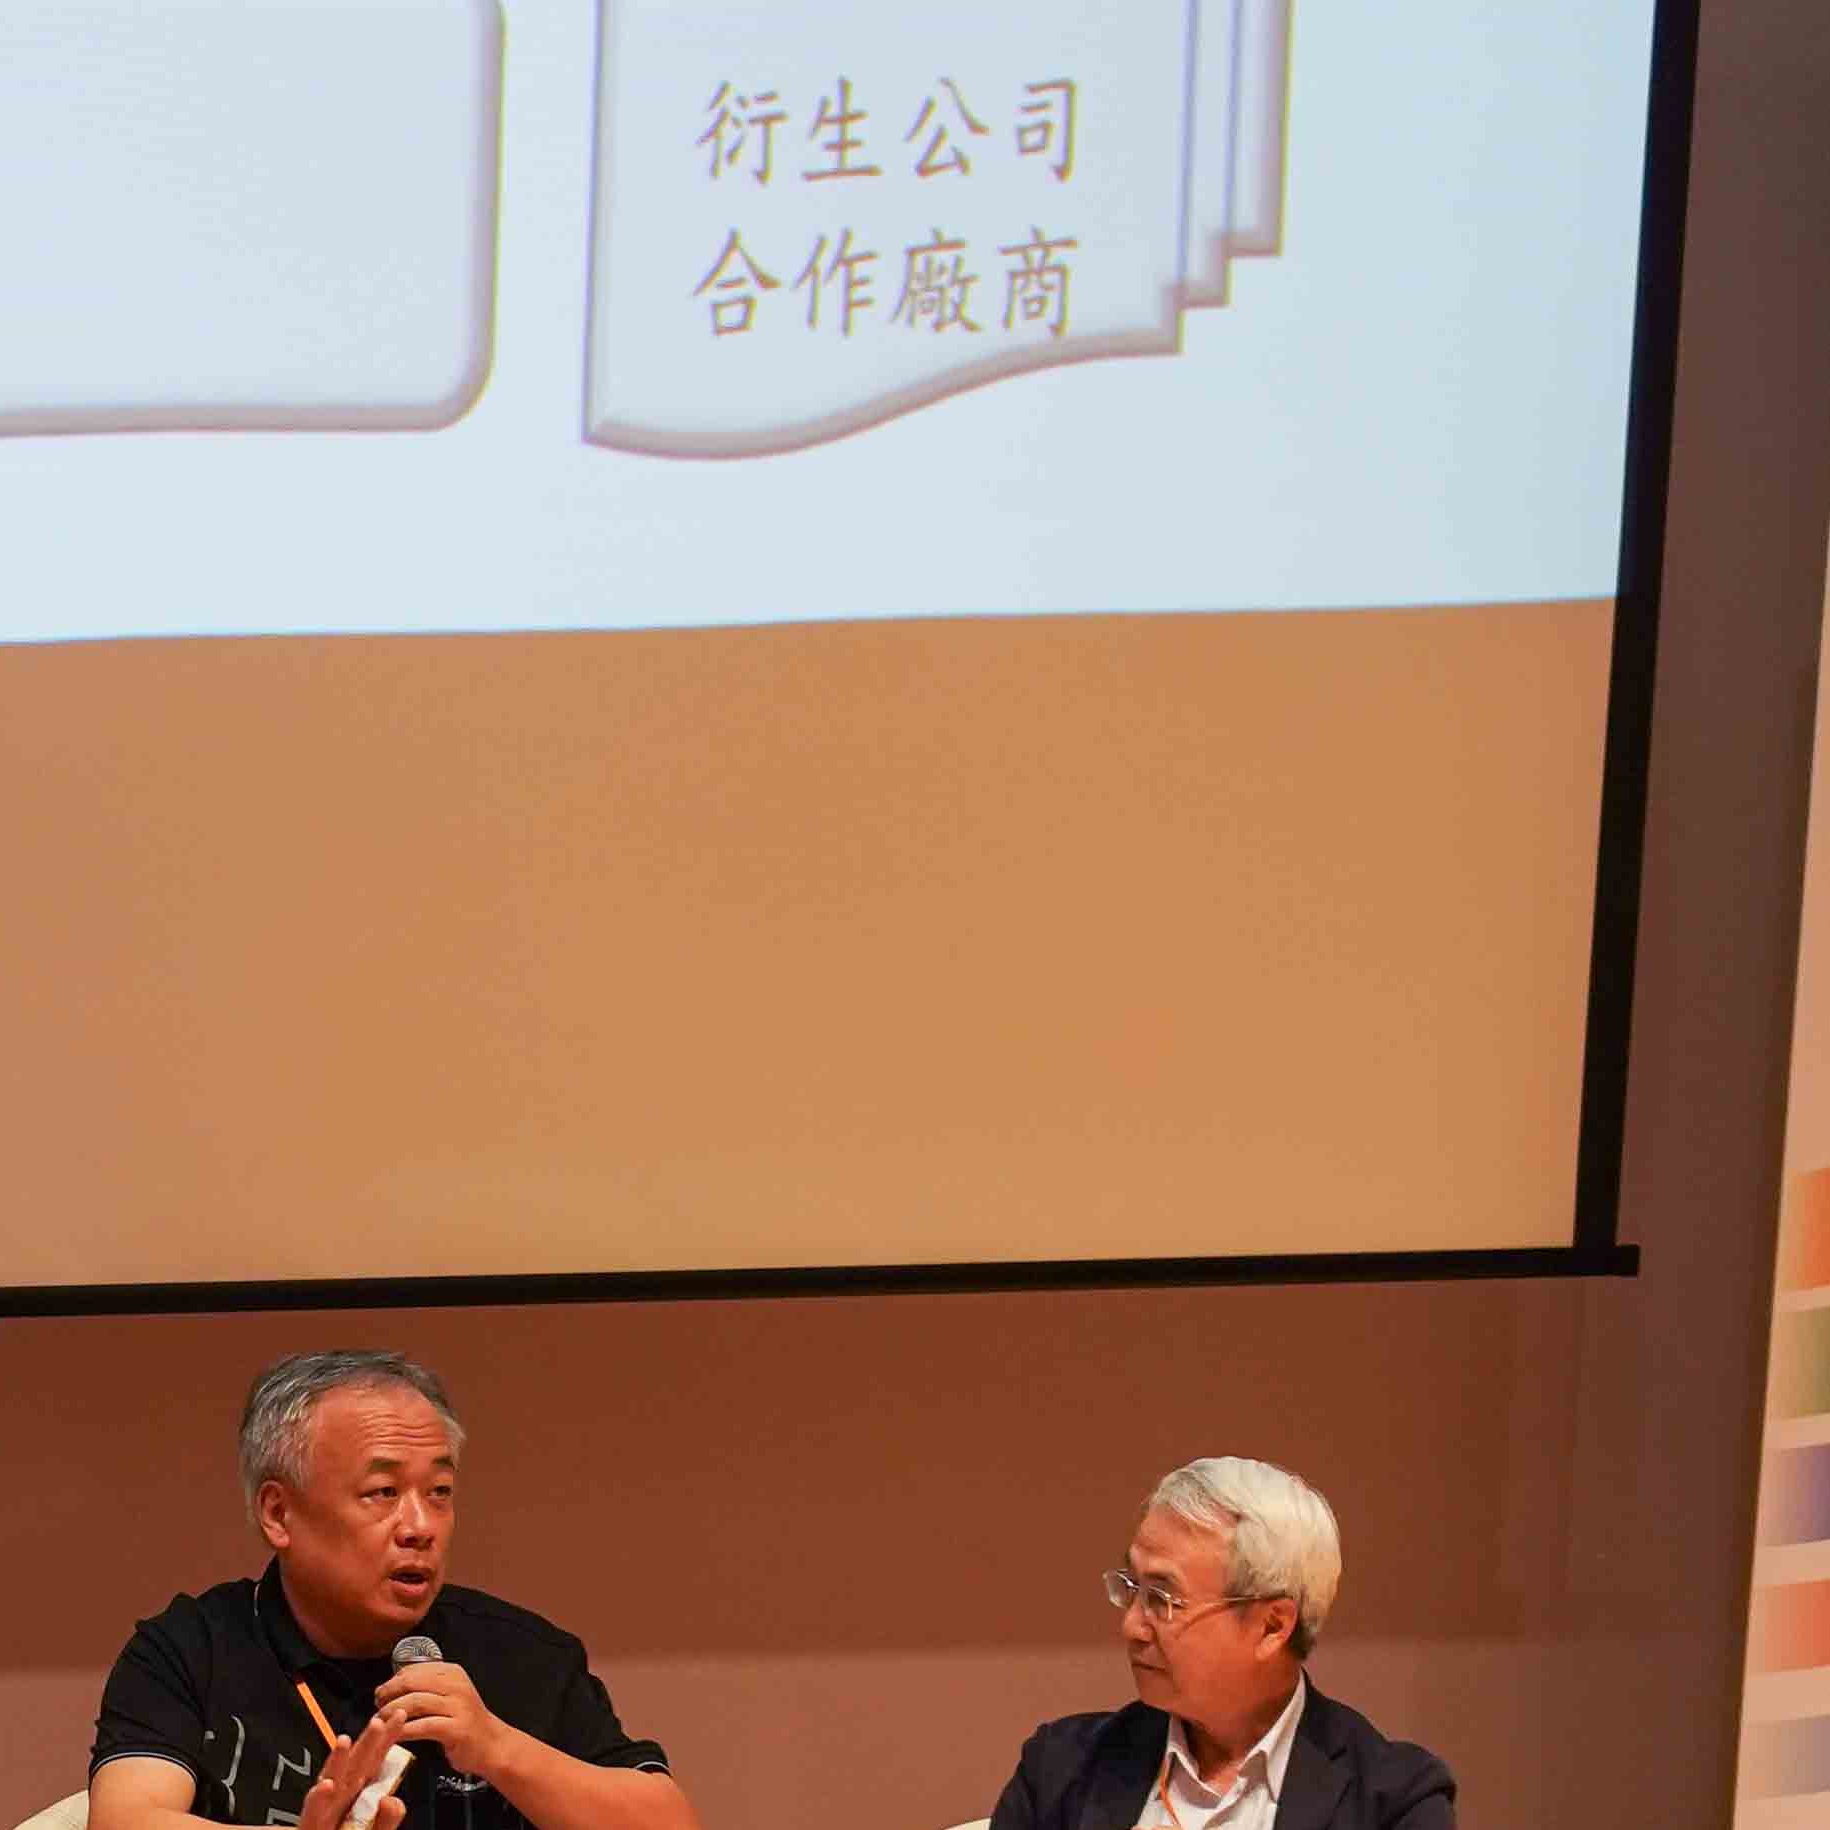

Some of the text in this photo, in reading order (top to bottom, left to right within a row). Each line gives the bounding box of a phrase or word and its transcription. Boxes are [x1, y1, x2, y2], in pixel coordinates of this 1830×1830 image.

[696, 77, 1078, 186] 衍生公司
[694, 228, 1079, 337] 合作廠商
